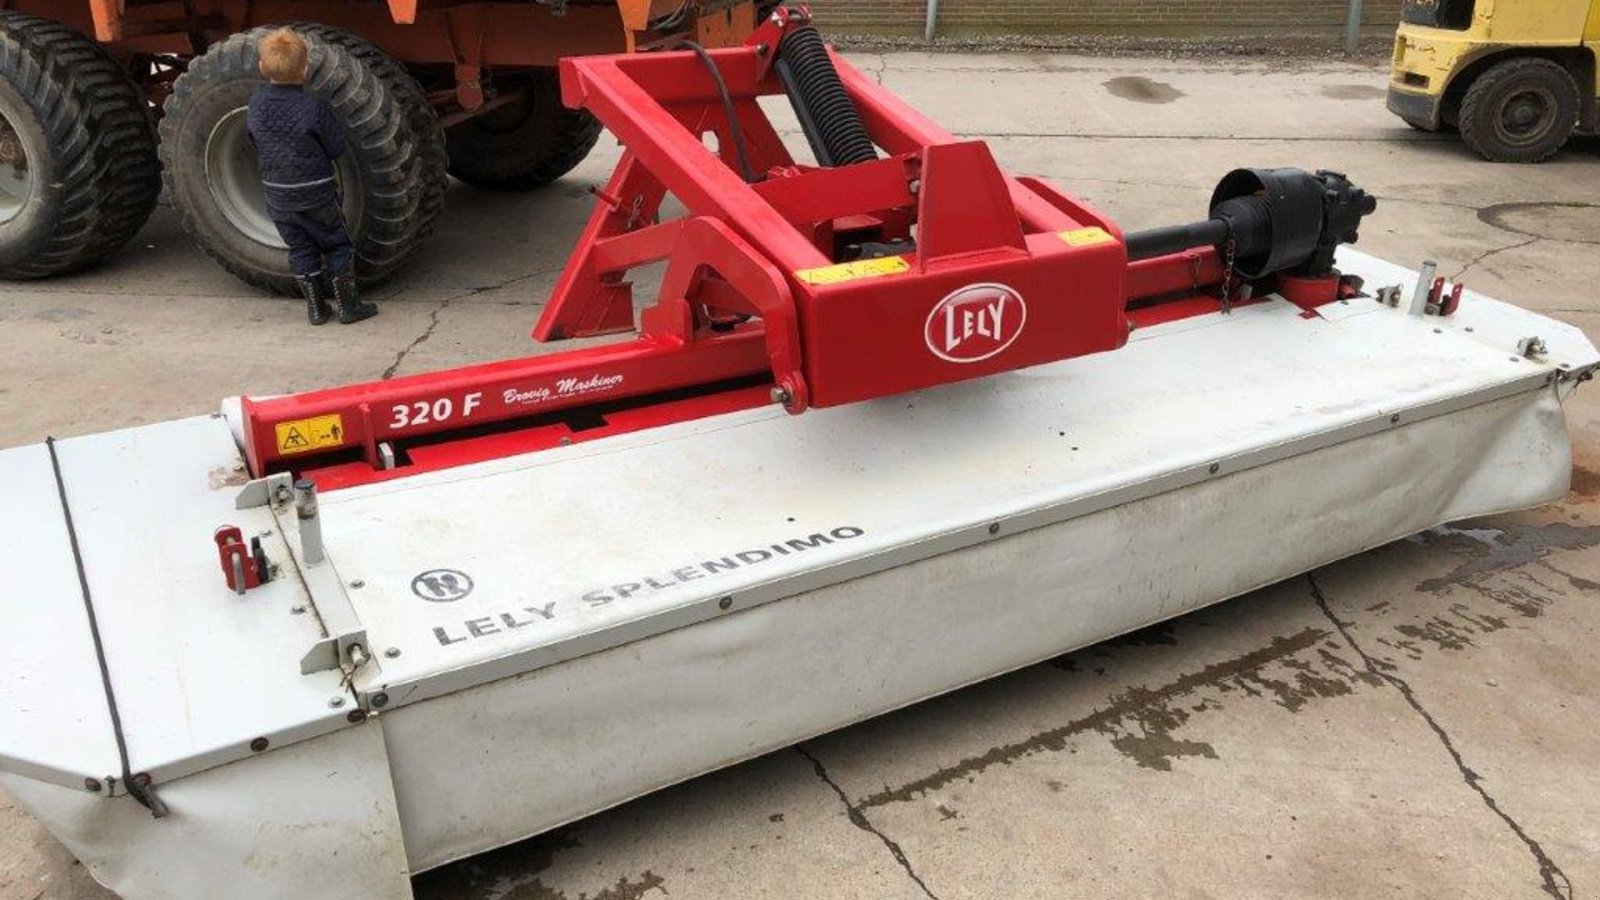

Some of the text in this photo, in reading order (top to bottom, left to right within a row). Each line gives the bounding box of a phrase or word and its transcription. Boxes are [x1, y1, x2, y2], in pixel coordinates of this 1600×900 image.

[946, 295, 1006, 352] LELY
[556, 374, 624, 393] Maskiner
[389, 392, 482, 429] 320 F
[432, 526, 864, 646] LELY SPLENDIMO
